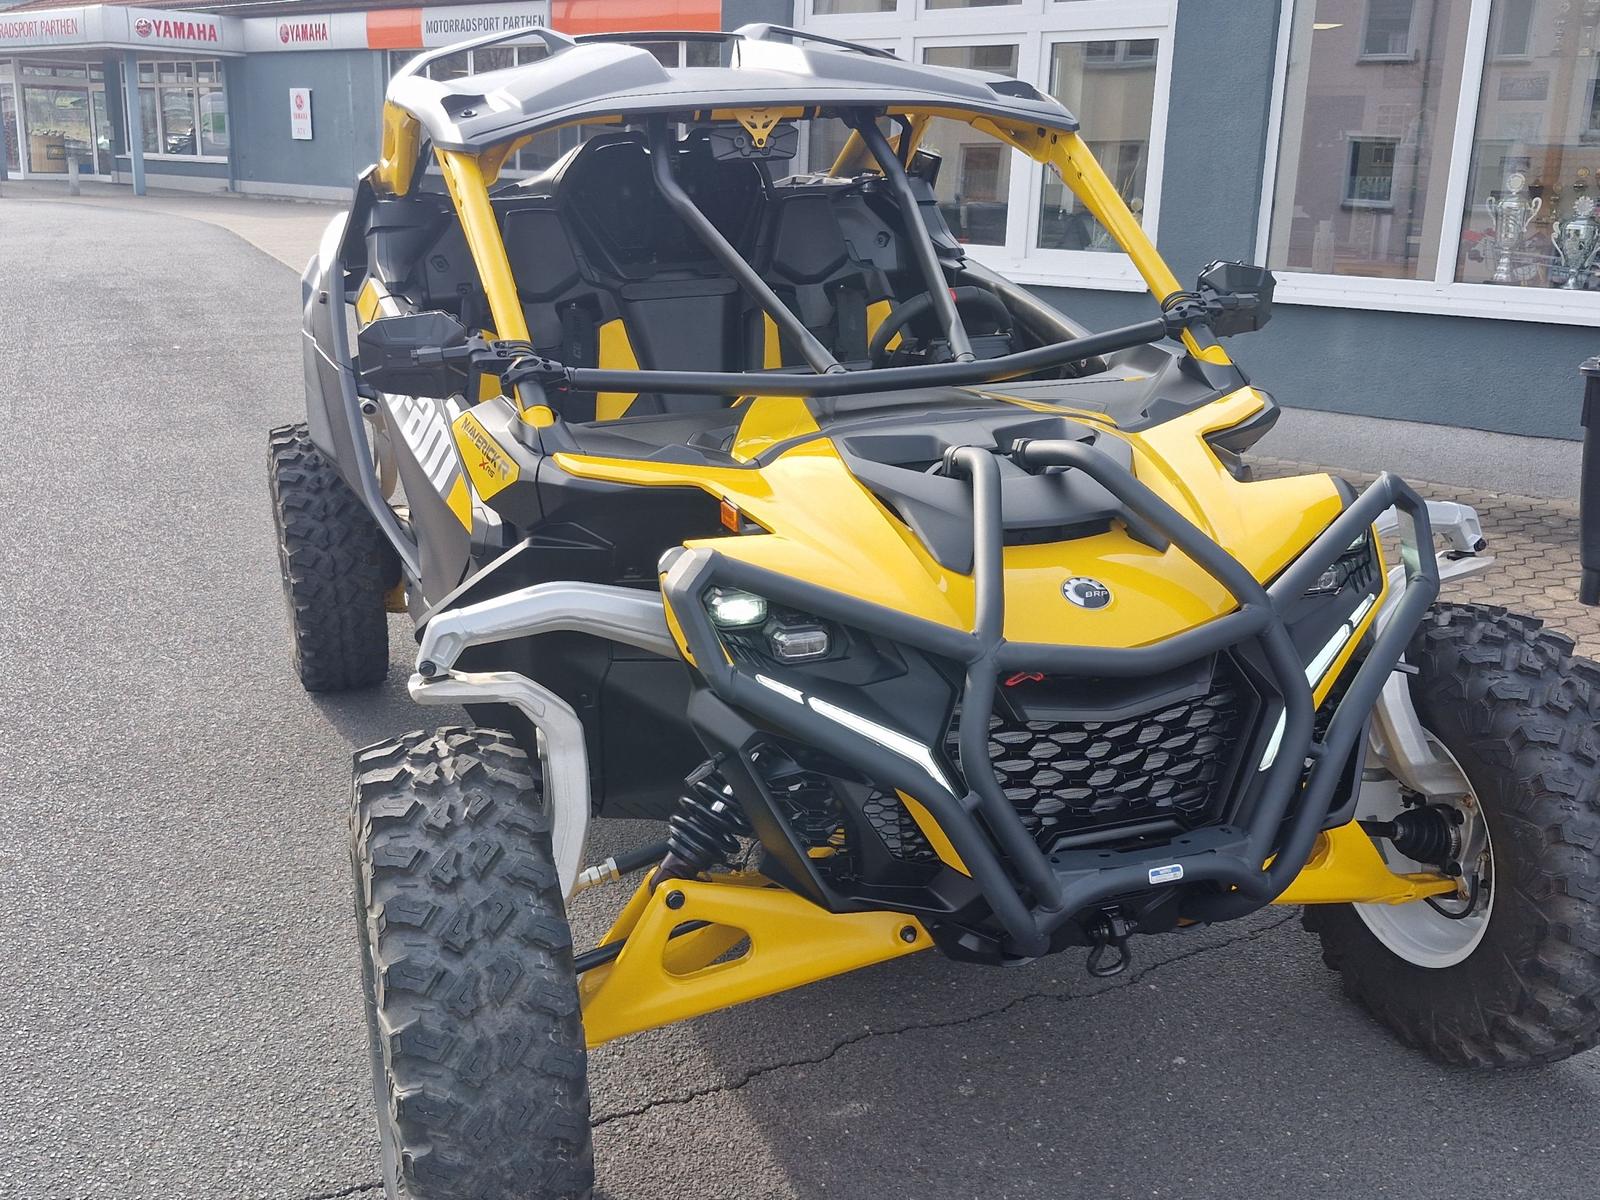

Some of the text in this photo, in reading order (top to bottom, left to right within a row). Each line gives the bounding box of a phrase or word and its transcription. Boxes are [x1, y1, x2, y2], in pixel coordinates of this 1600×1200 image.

[40, 18, 79, 36] PARTHEN
[152, 19, 218, 42] YAMAHA
[289, 22, 328, 42] YAMAHA
[425, 14, 545, 34] MOTORRADSPORT PARTHEN
[461, 416, 501, 469] MAVERICK
[1085, 589, 1108, 598] BRP
